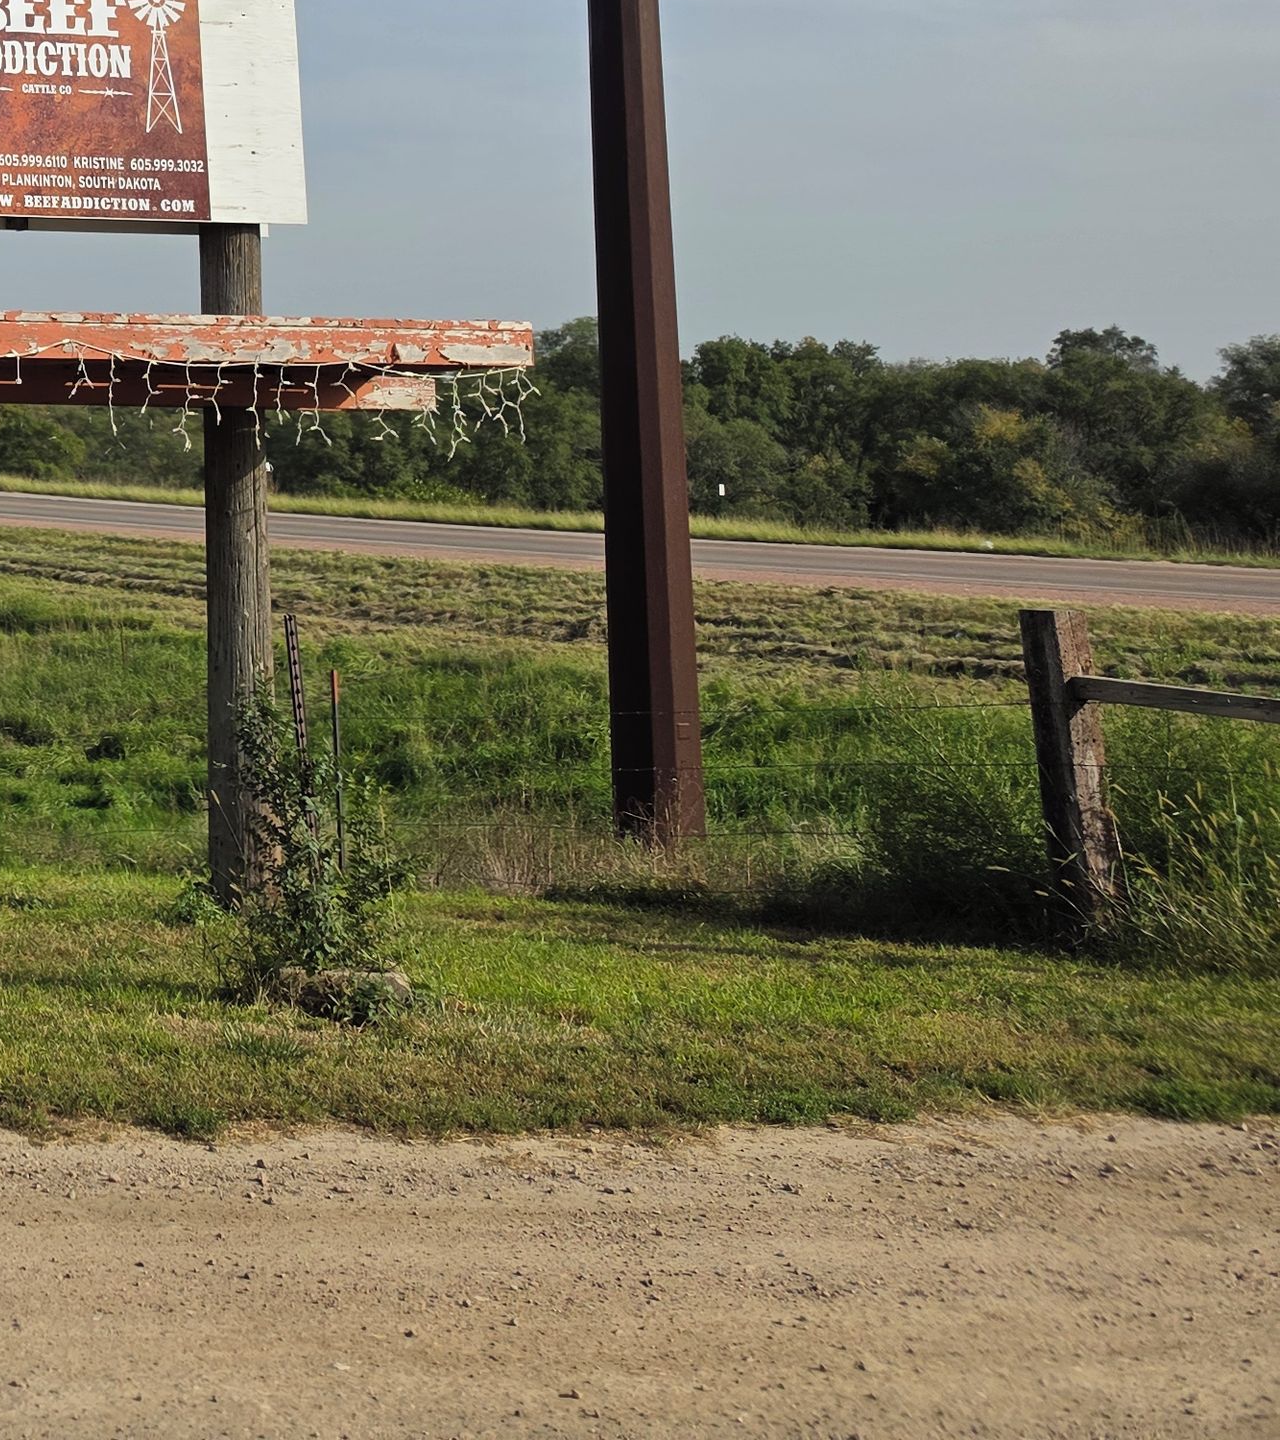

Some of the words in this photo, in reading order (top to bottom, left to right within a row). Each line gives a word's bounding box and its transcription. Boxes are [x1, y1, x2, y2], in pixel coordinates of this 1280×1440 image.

[21, 83, 57, 95] CATTLE
[73, 156, 125, 170] KRISTINE
[130, 158, 205, 172] 605.999.3032
[2, 173, 76, 189] PLANKINTON,
[78, 175, 115, 189] SOUTH
[118, 177, 161, 190] DAKOTA
